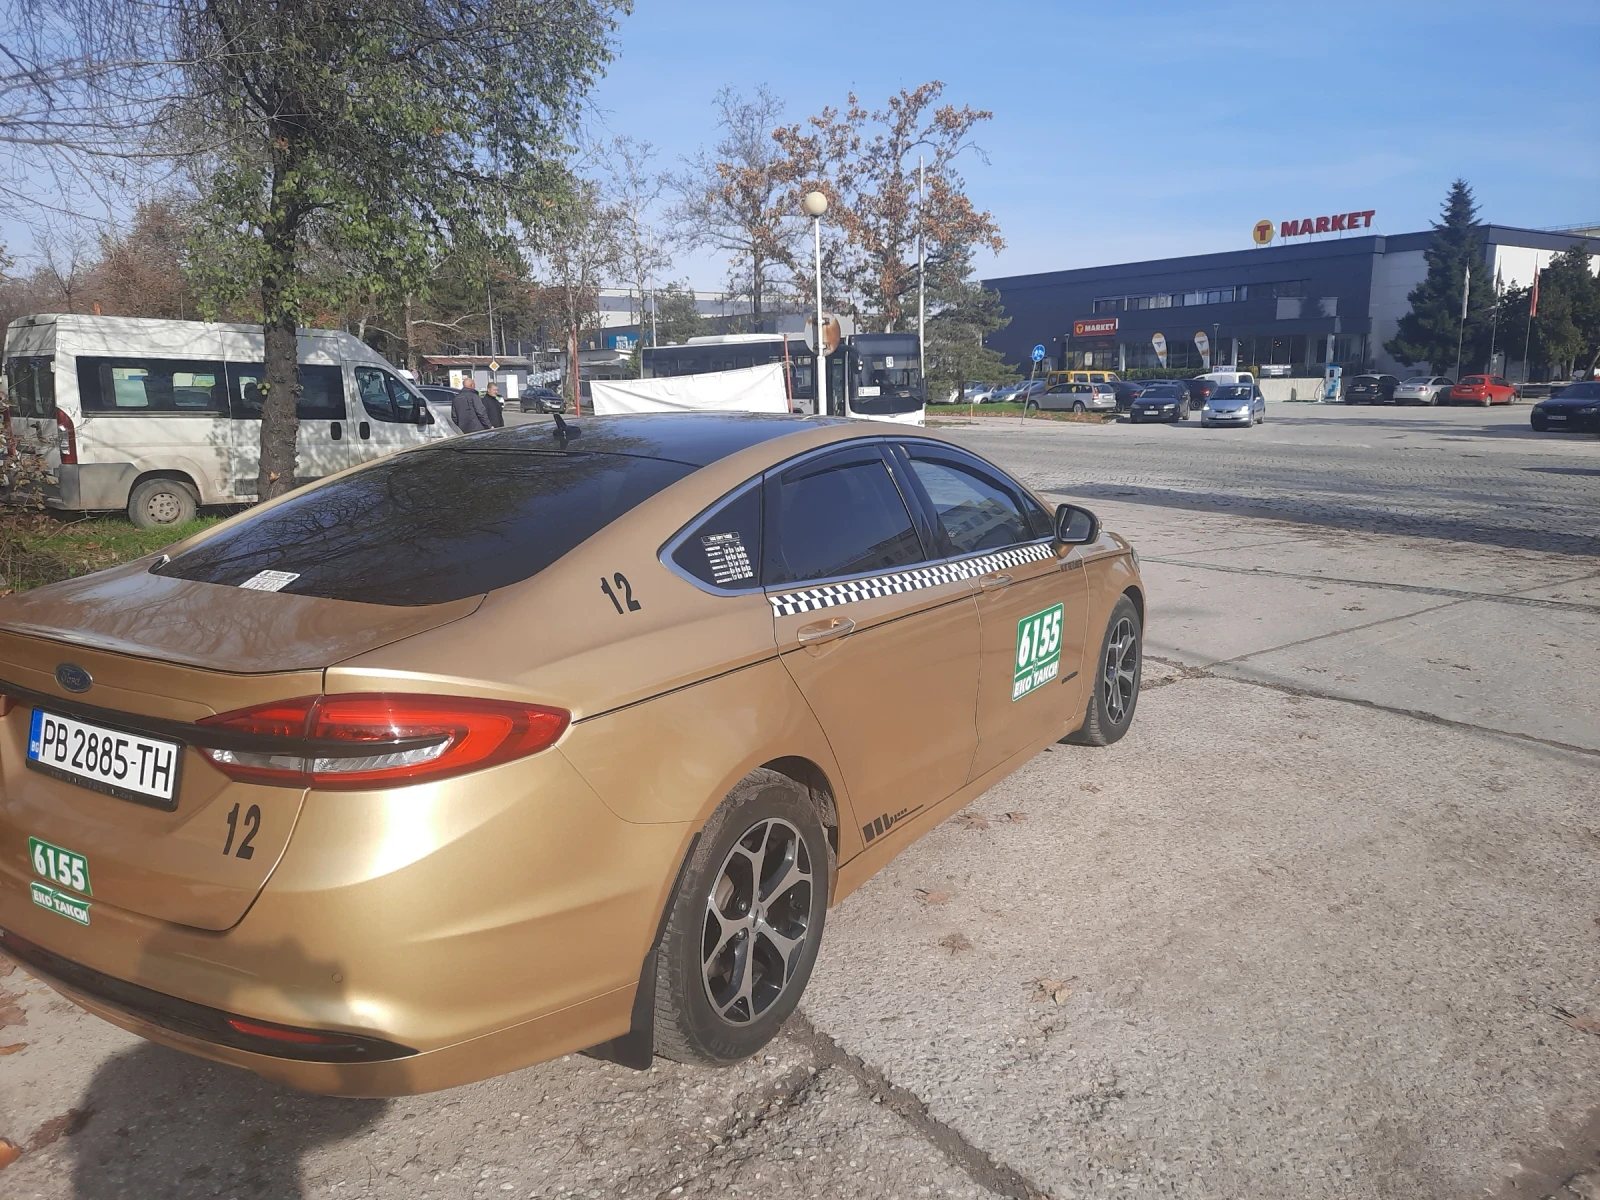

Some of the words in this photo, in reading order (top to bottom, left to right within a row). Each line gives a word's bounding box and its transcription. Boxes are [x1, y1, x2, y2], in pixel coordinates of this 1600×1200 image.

[1257, 224, 1270, 241] T
[1281, 210, 1375, 237] MARKET
[1085, 323, 1114, 332] MARKET
[600, 572, 642, 615] 12
[1018, 609, 1061, 667] 6155
[42, 719, 68, 763] PB
[71, 728, 172, 792] 2885-TH
[223, 803, 261, 860] 12
[34, 844, 85, 891] 6155
[33, 889, 53, 907] ЕКО
[53, 899, 88, 922] ТАКСИ
